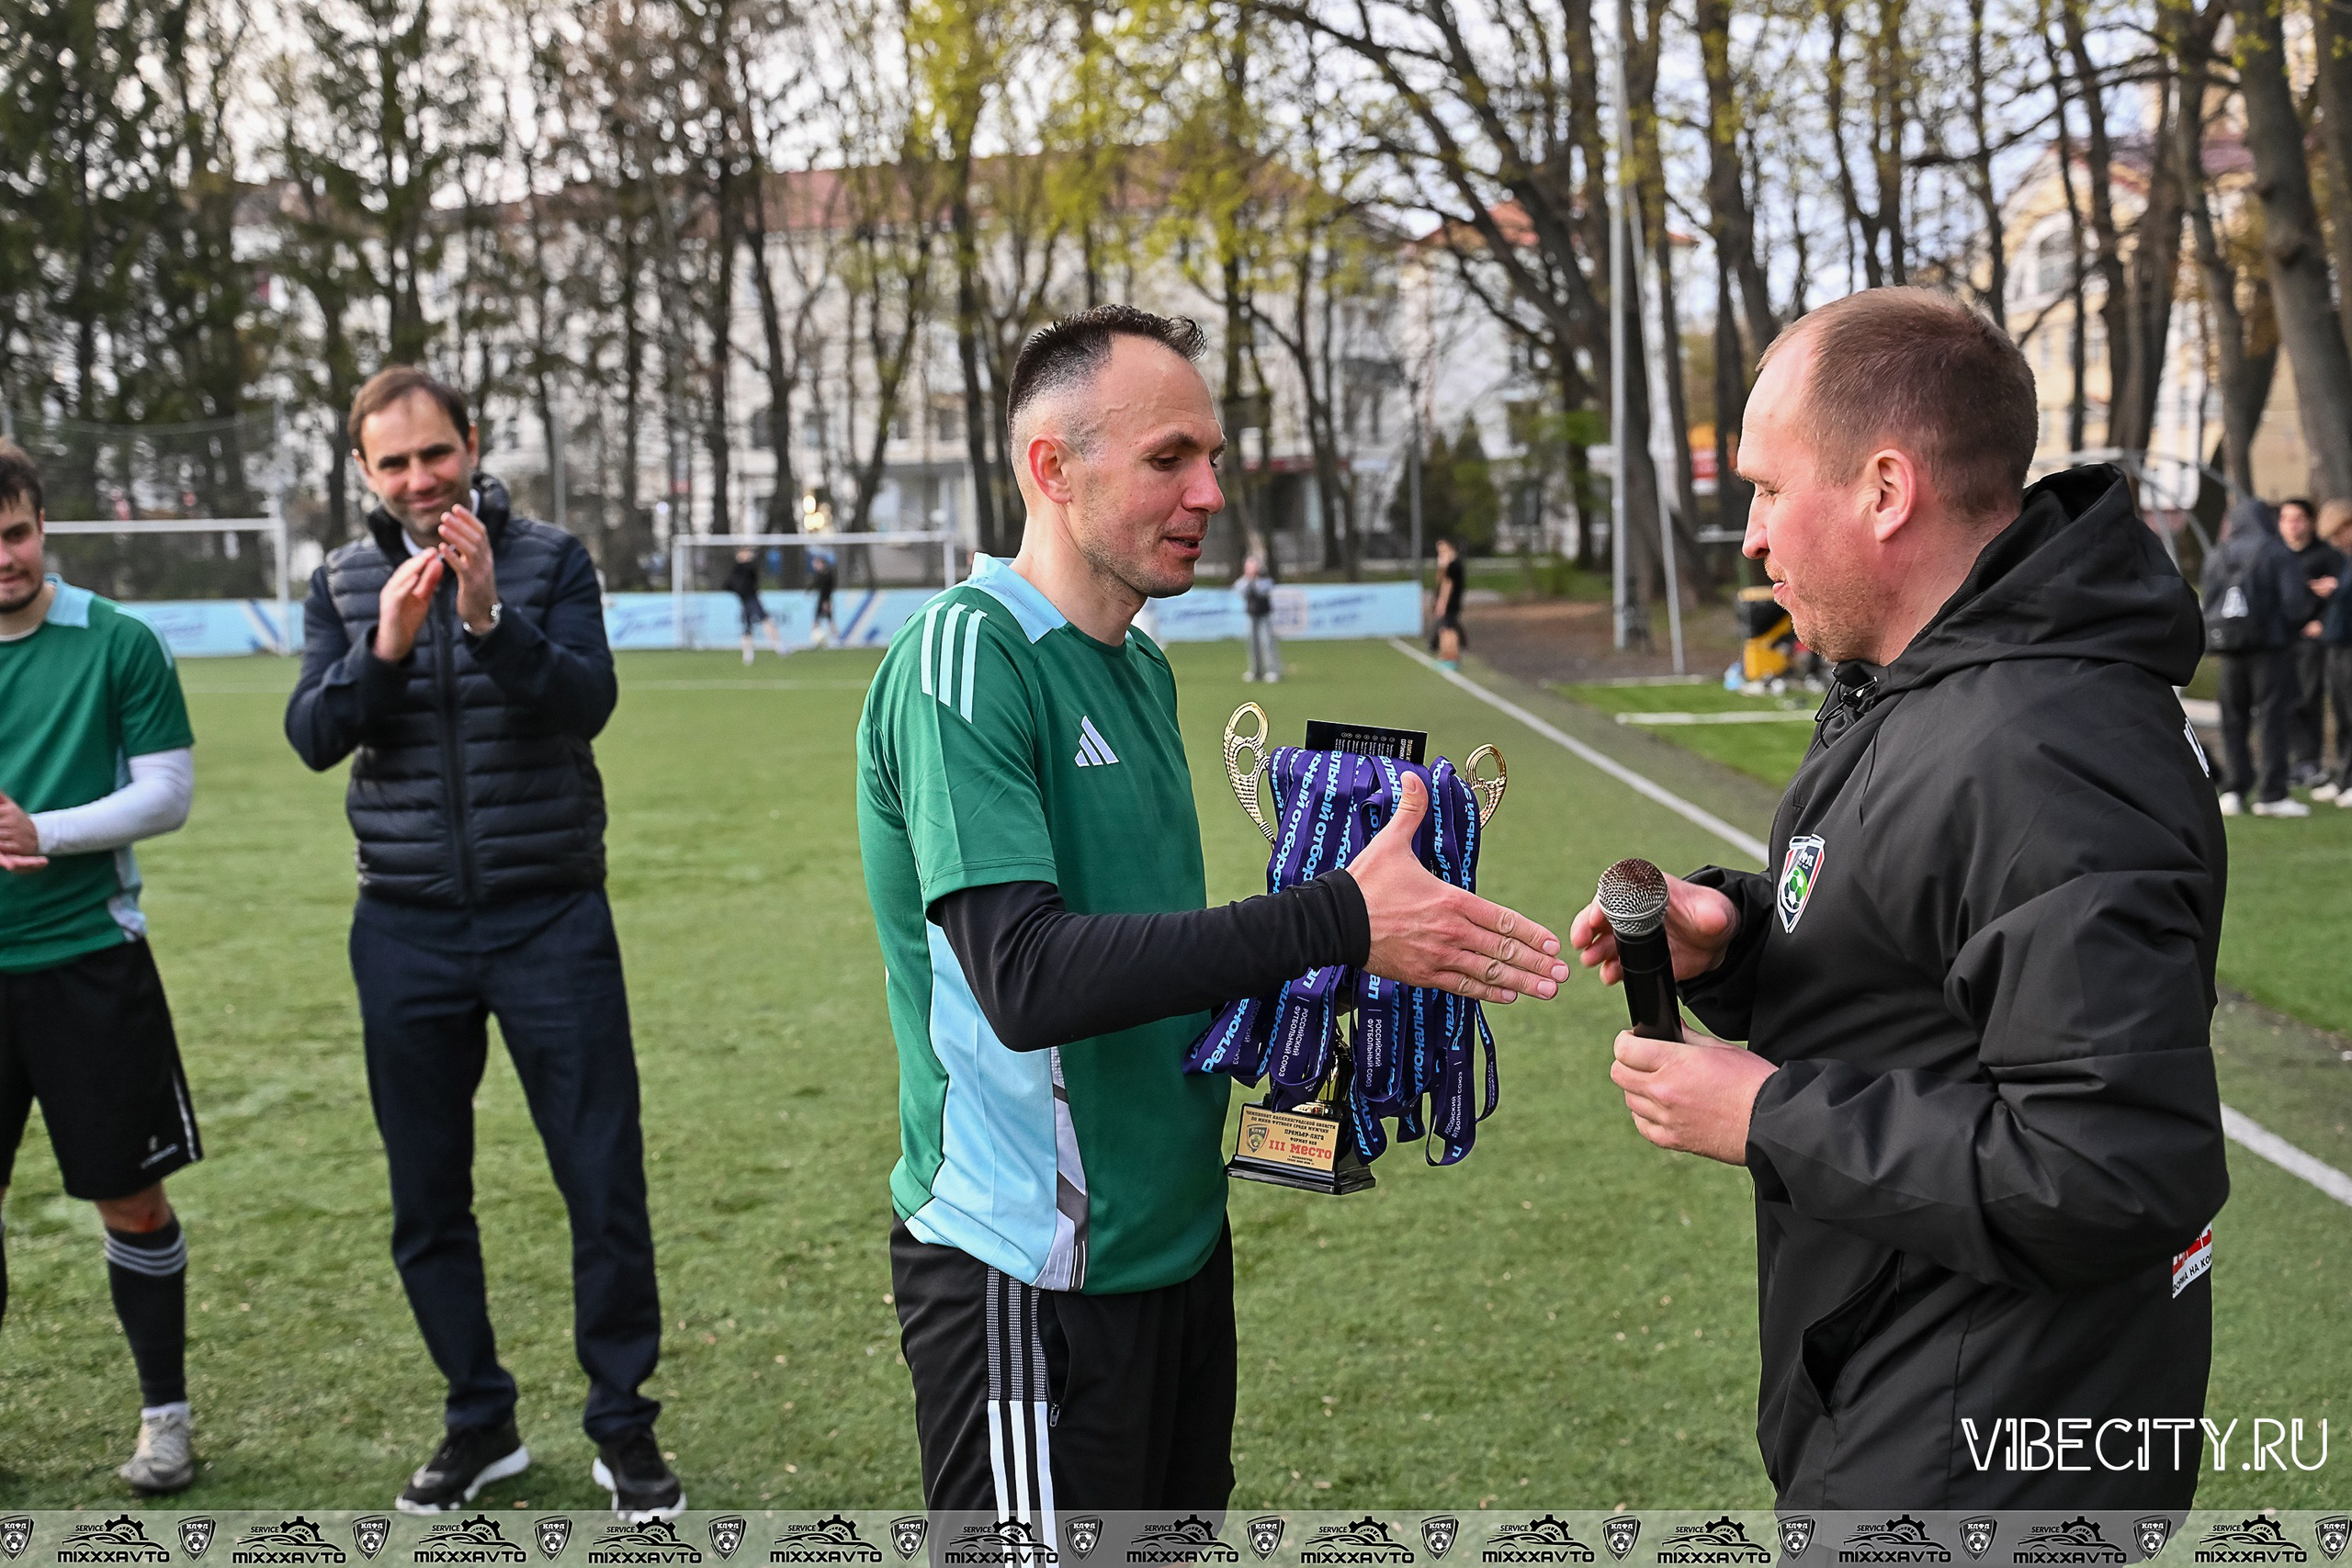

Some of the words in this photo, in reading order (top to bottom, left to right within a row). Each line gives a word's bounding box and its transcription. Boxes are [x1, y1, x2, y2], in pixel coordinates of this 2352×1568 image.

[1284, 1005, 1301, 1055] ФУТБОЛЬНЫЙ
[1292, 1008, 1309, 1056] РОССИЙСКИЙ
[1366, 1018, 1374, 1068] ФУТБОЛЬНЫЙ
[1374, 1019, 1383, 1067] РОССИЙСКИЙ
[1279, 1055, 1290, 1077] СОЮЗ
[1365, 1067, 1374, 1088] СОЮЗ
[2200, 1253, 2212, 1268] КО
